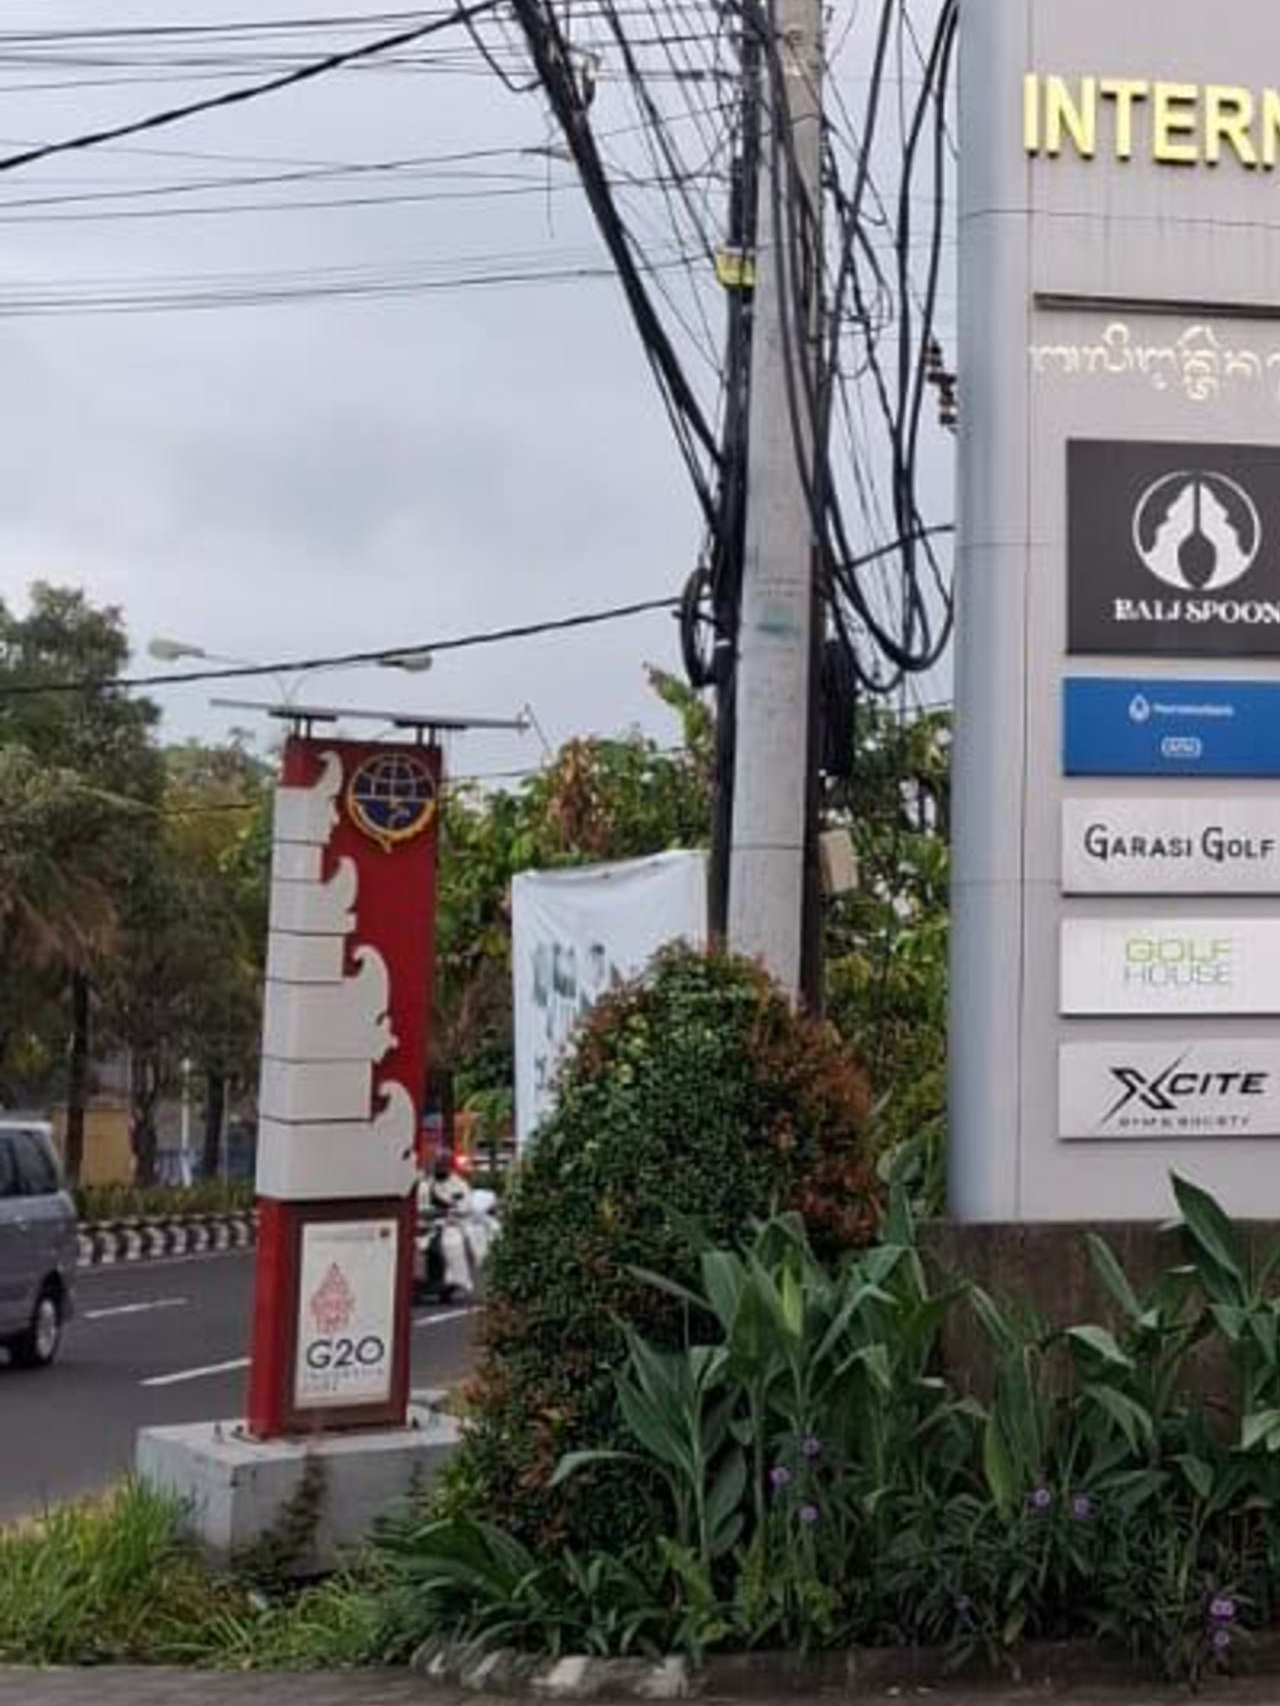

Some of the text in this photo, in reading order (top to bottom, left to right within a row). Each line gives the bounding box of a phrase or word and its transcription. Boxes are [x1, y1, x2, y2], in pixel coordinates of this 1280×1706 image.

[1083, 823, 1277, 863] GARASI GOLF
[1125, 938, 1233, 963] GOLF
[1123, 964, 1233, 987] HOUSE
[1101, 1048, 1270, 1123] XCITE
[306, 1334, 386, 1370] G20
